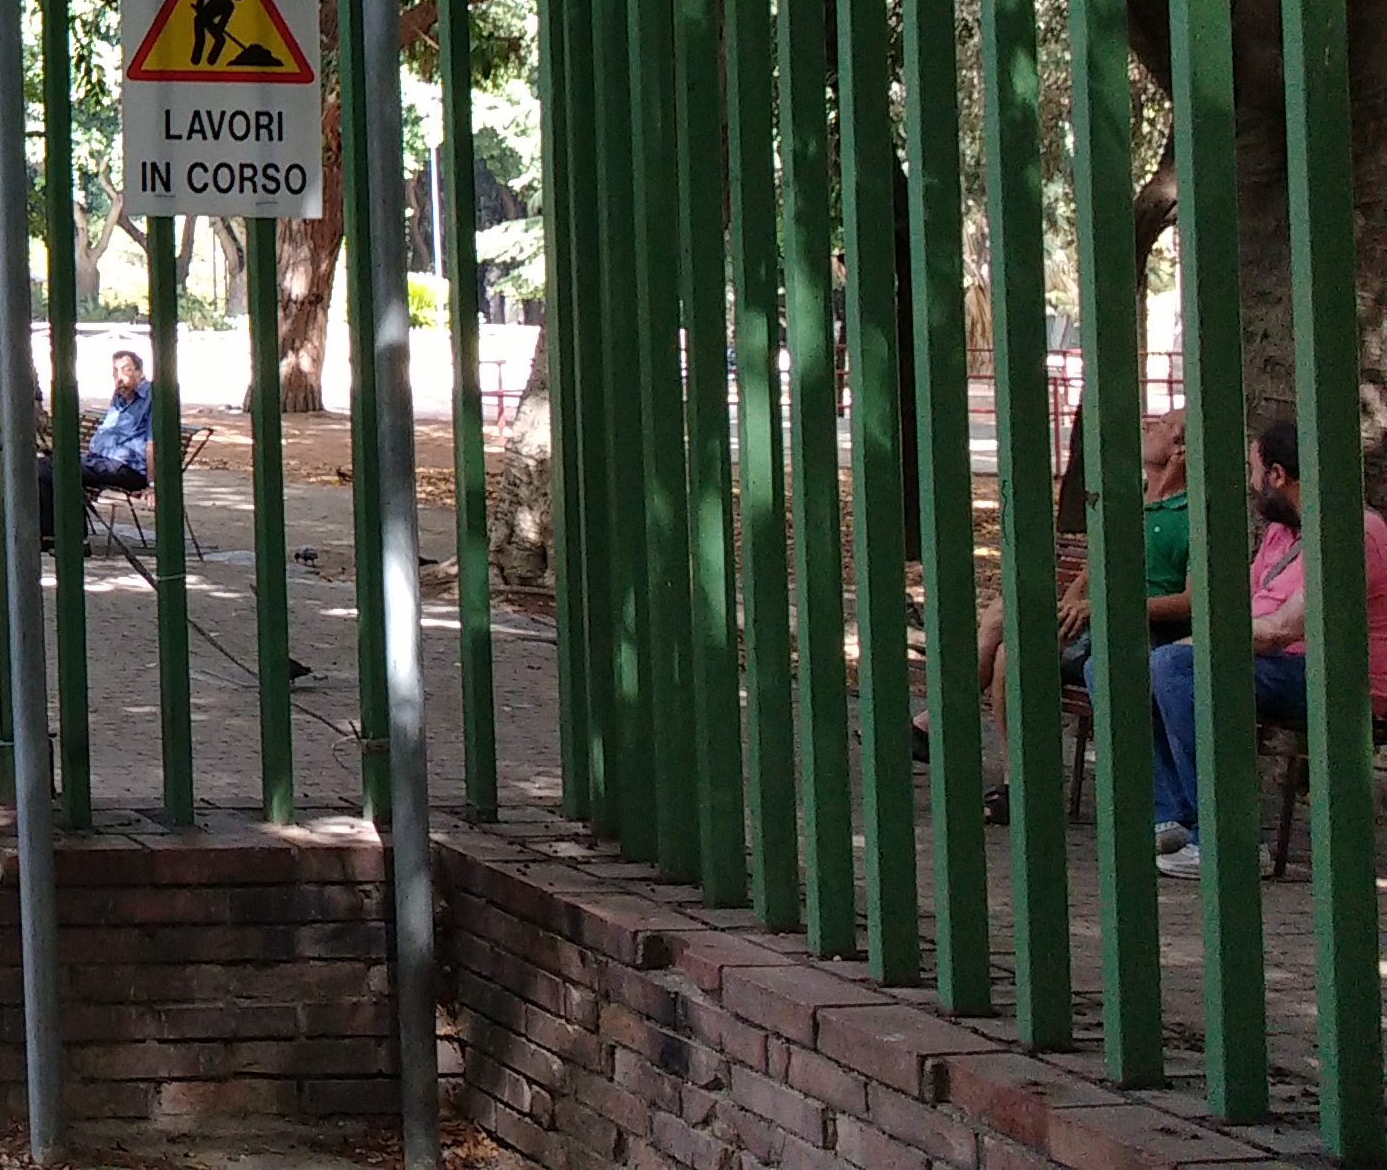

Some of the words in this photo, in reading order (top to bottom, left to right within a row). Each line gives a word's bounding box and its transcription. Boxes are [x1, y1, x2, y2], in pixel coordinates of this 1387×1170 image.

[165, 109, 283, 141] LAVORI
[142, 162, 171, 192] IN
[187, 162, 306, 195] CORSO
